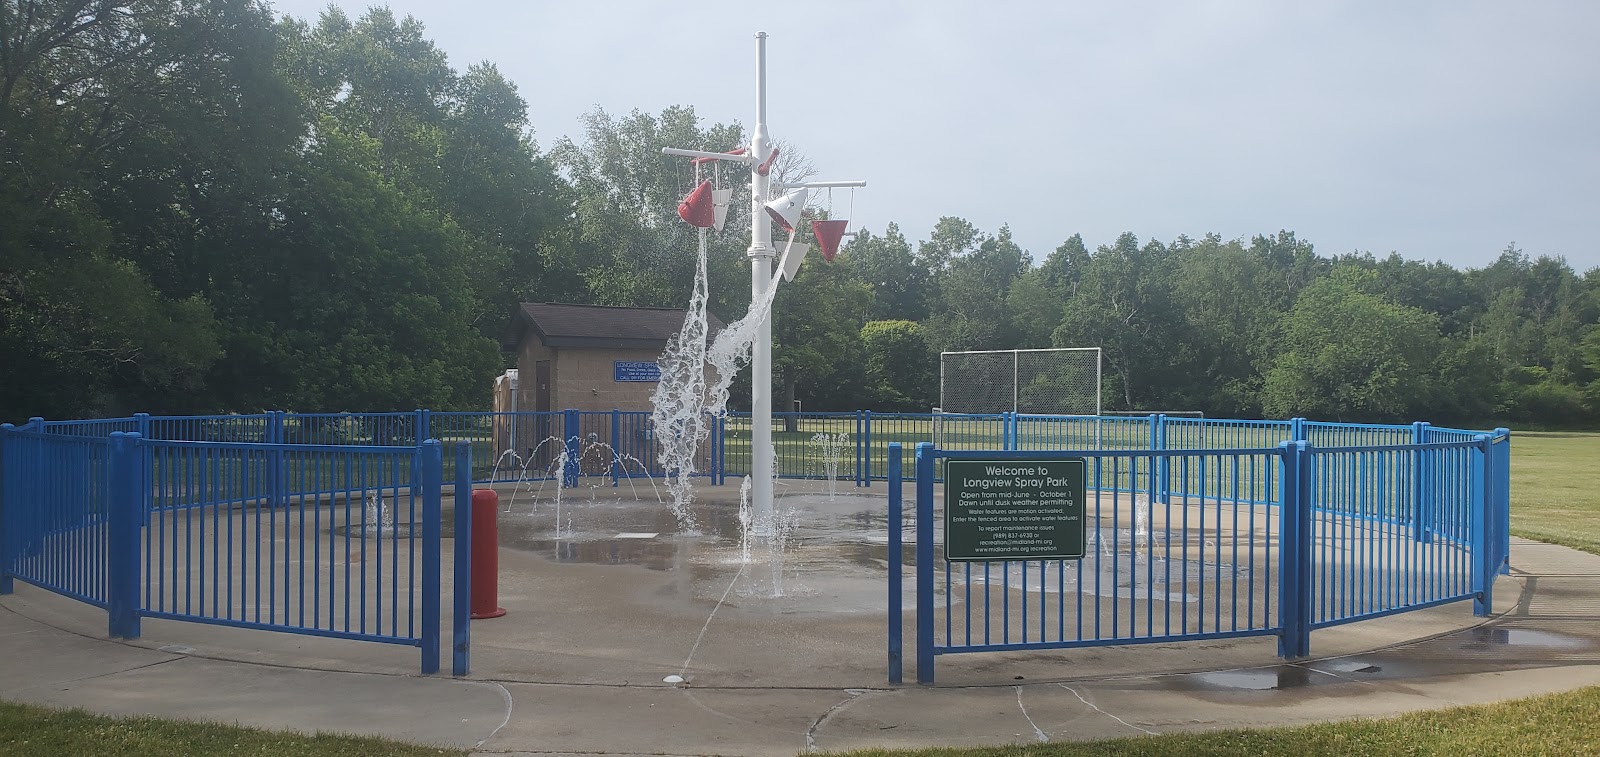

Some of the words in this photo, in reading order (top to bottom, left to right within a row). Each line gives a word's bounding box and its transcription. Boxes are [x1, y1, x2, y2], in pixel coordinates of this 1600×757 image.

[985, 466, 1034, 475] Welcome
[1038, 466, 1048, 475] to
[964, 478, 1012, 489] Longview
[1015, 478, 1044, 488] Spray
[1047, 477, 1068, 486] Park
